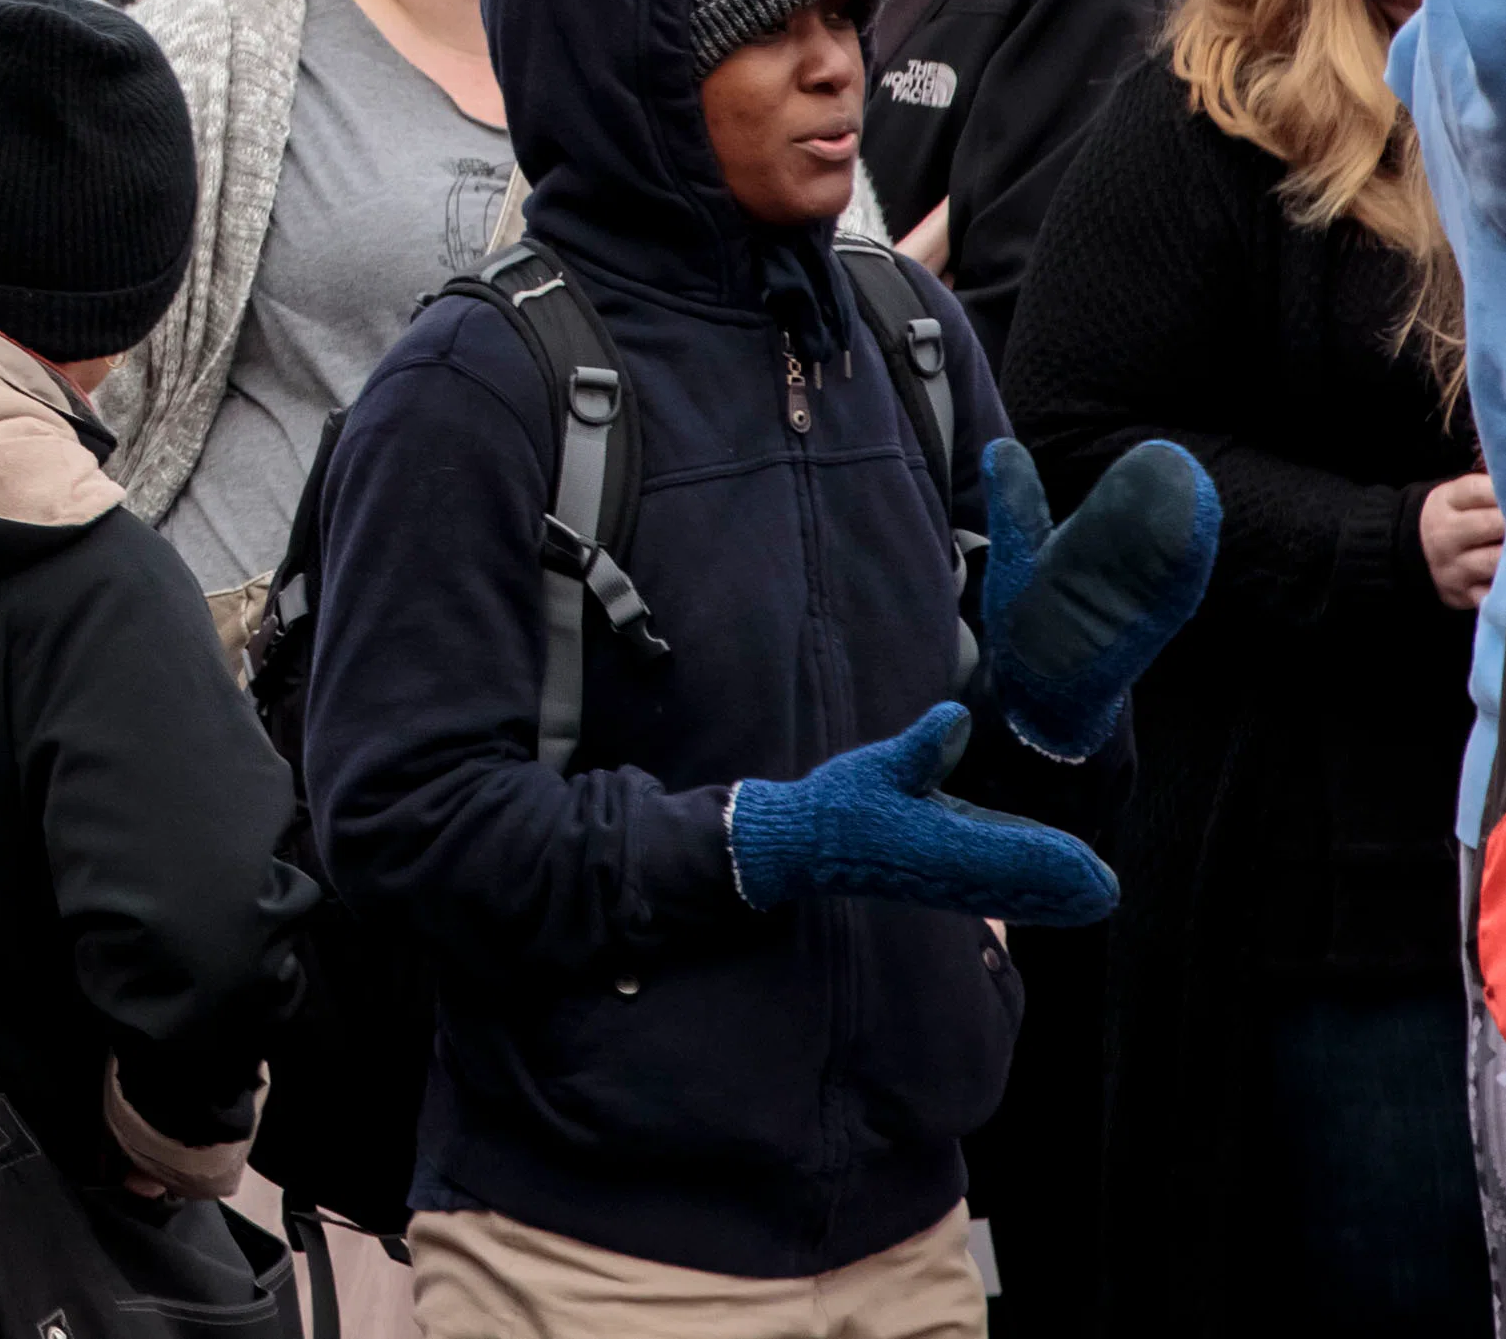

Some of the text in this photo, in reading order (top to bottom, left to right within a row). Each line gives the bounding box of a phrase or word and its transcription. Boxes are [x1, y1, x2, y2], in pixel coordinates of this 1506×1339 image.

[907, 58, 939, 77] THE
[880, 70, 936, 91] NORTH
[891, 85, 938, 108] FACE
